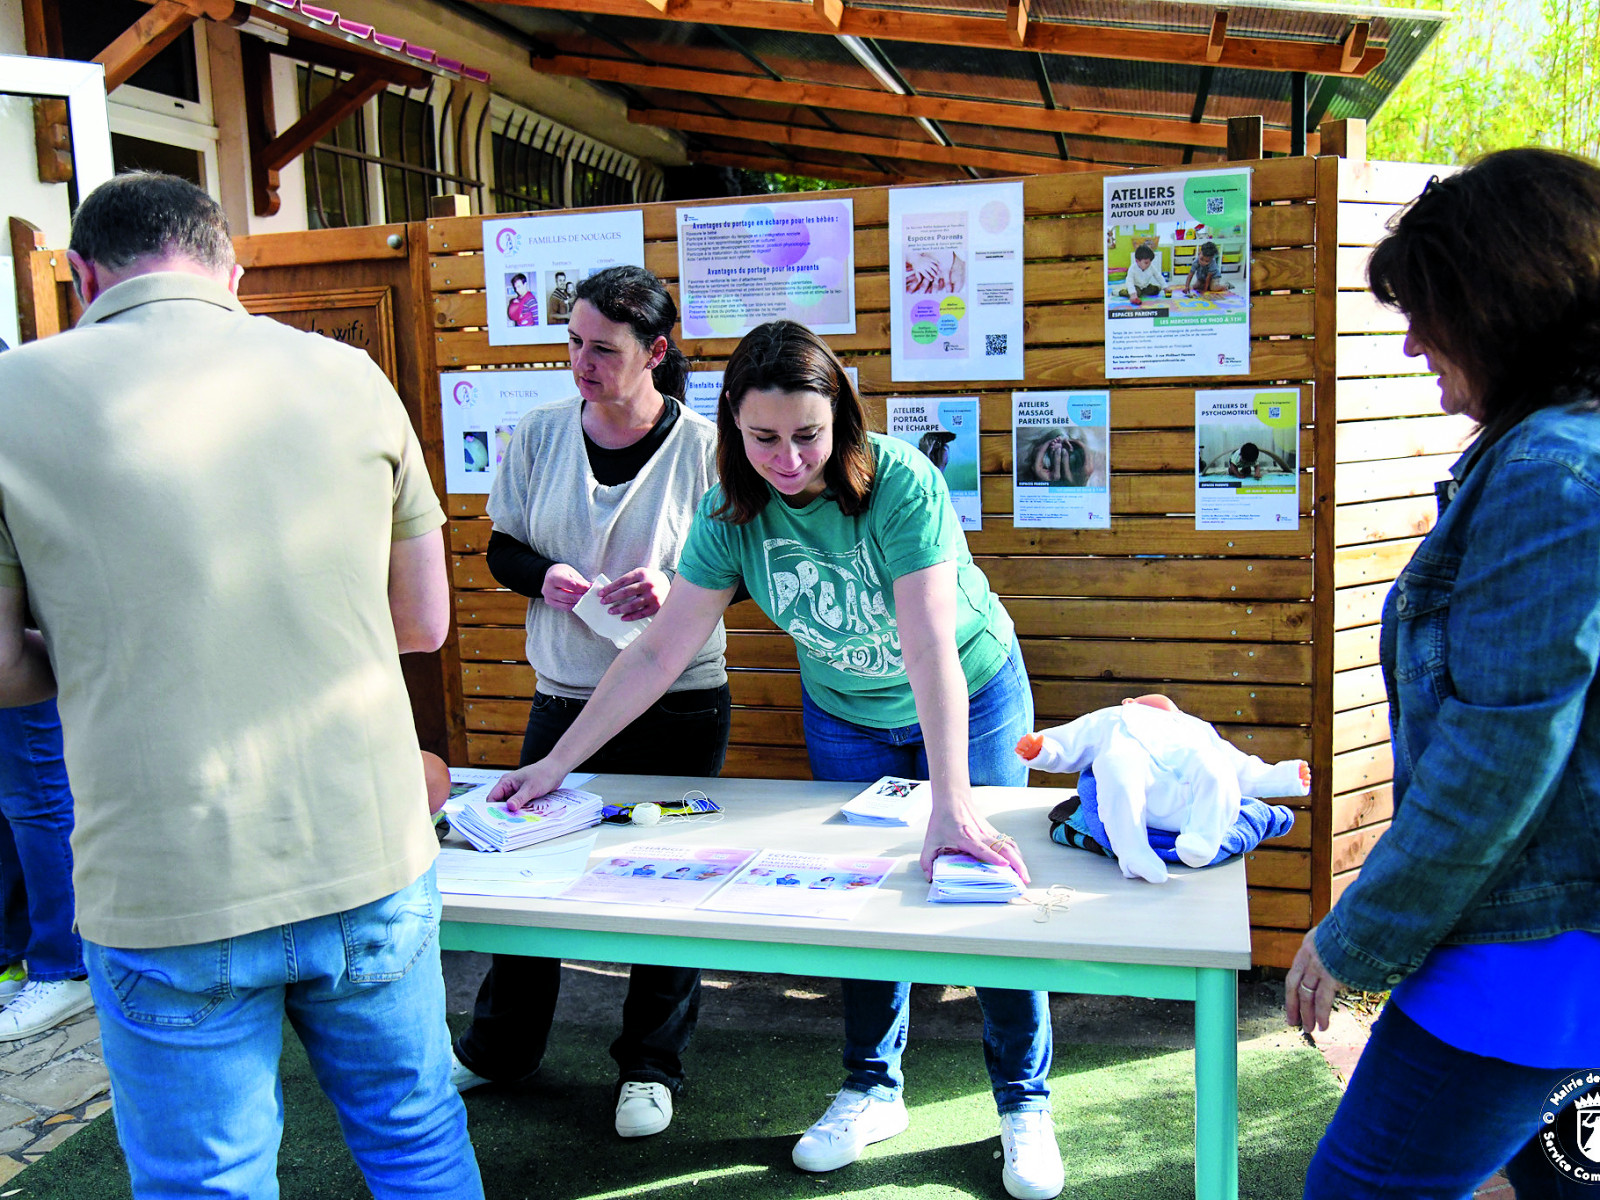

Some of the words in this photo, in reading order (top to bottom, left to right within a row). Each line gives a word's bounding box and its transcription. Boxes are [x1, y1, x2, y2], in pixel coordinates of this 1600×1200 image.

[1111, 186, 1175, 201] ATELIERS
[1111, 210, 1144, 218] AUTOUR
[692, 222, 722, 230] Avantages
[732, 220, 754, 229] portage
[528, 236, 566, 245] FAMILLES
[581, 232, 622, 241] NOUAGES
[747, 267, 770, 275] portage
[906, 423, 939, 431] ÉCHARPE
[772, 560, 897, 634] DREAM
